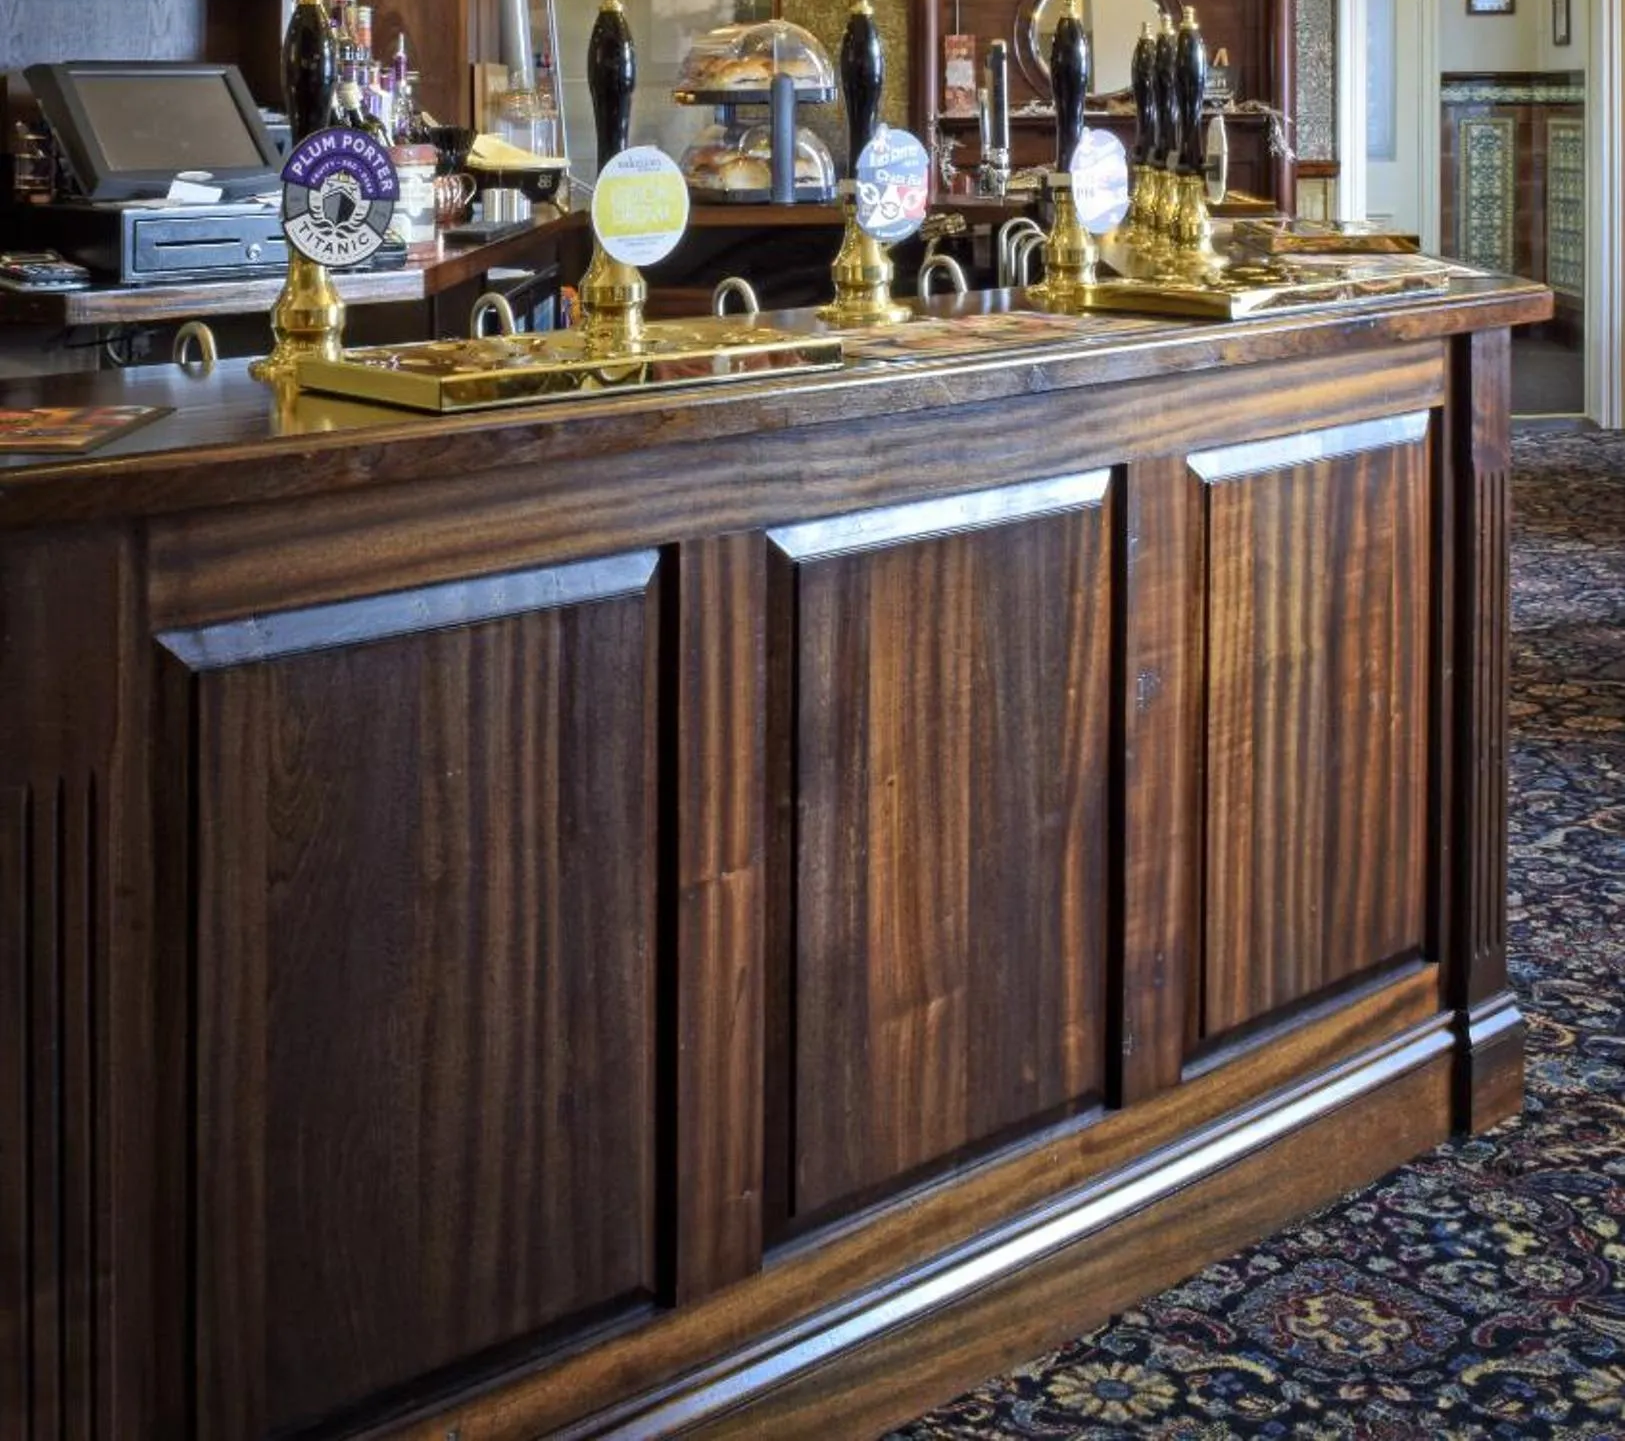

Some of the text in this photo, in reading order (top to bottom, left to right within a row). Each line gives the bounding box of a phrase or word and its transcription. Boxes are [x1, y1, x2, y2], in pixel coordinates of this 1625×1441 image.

[292, 136, 337, 177] PLUM
[341, 135, 394, 192] PORTER
[299, 220, 370, 254] TITANIC
